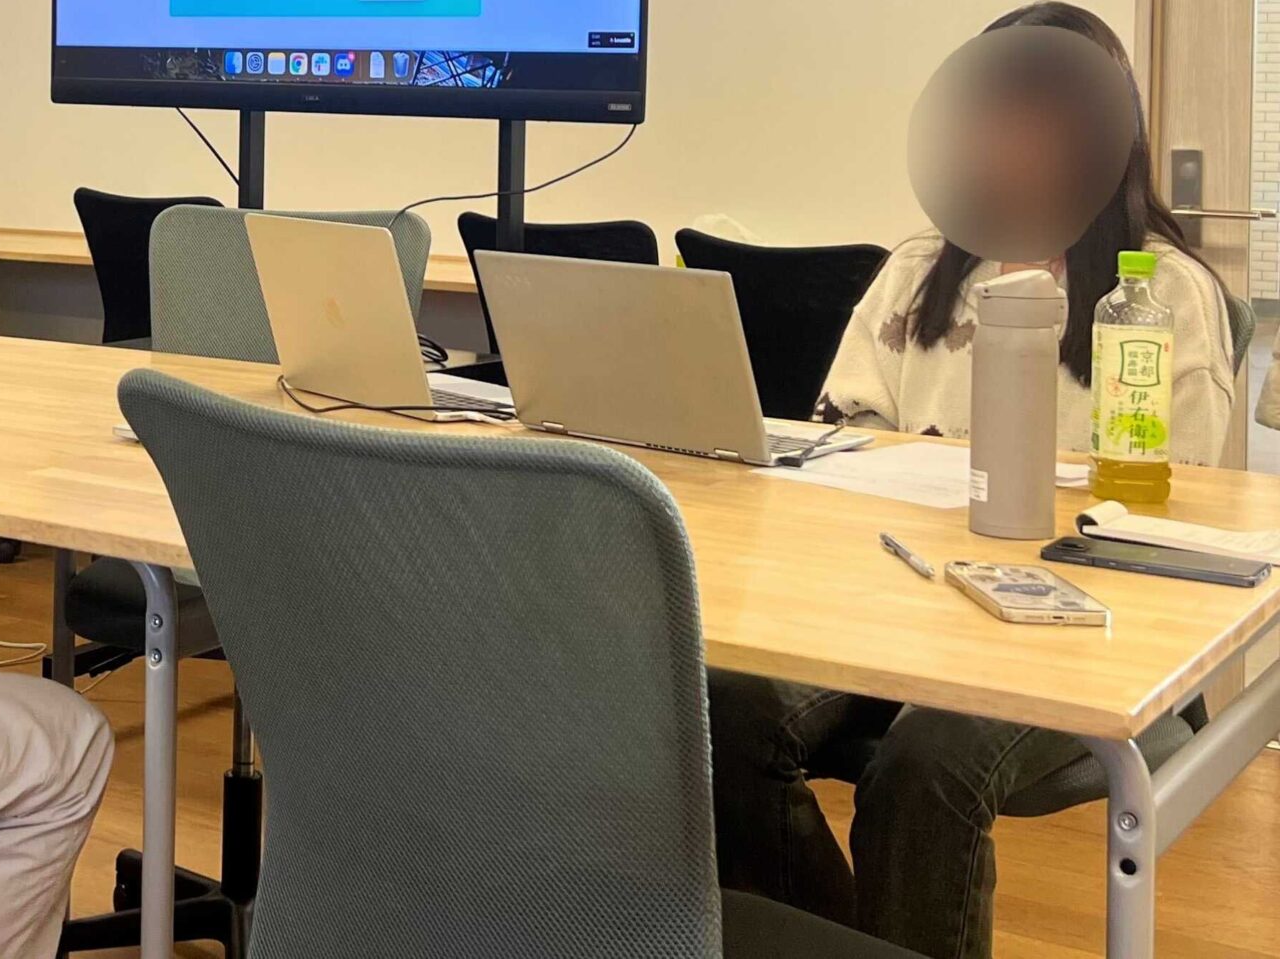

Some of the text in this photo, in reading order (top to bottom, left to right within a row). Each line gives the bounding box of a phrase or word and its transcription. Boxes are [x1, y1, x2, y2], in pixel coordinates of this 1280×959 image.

[1140, 350, 1155, 378] 京都
[1129, 390, 1150, 455] 伊右衛門
